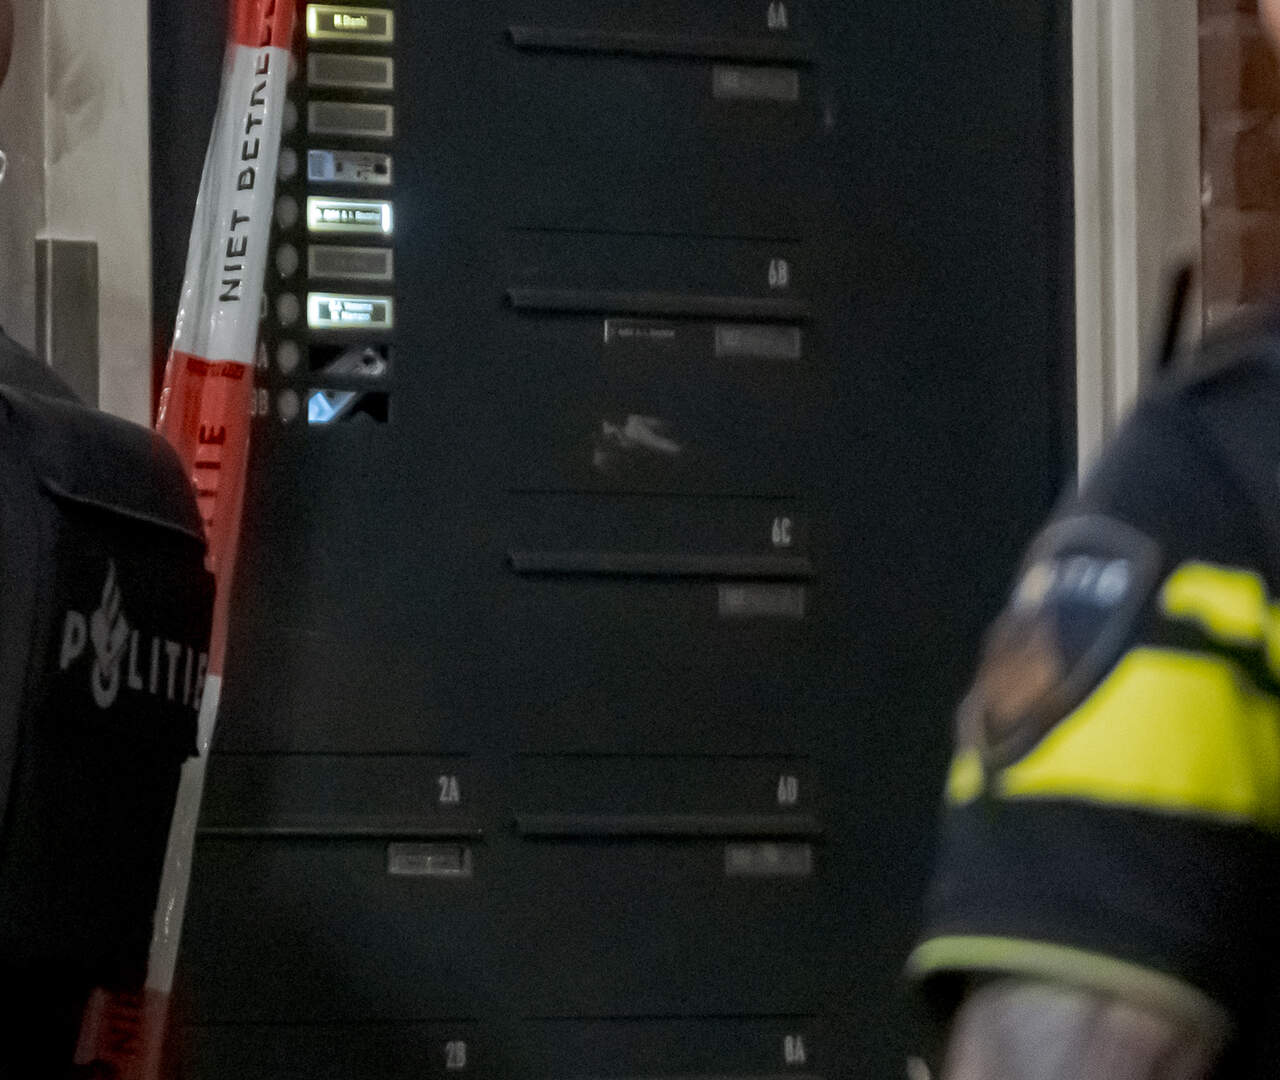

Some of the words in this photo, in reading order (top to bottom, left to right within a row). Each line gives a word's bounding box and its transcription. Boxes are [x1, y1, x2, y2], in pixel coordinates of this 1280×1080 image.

[219, 209, 251, 303] NIET
[771, 517, 792, 545] 6C
[438, 775, 460, 803] 2A
[446, 1040, 467, 1069] 2B
